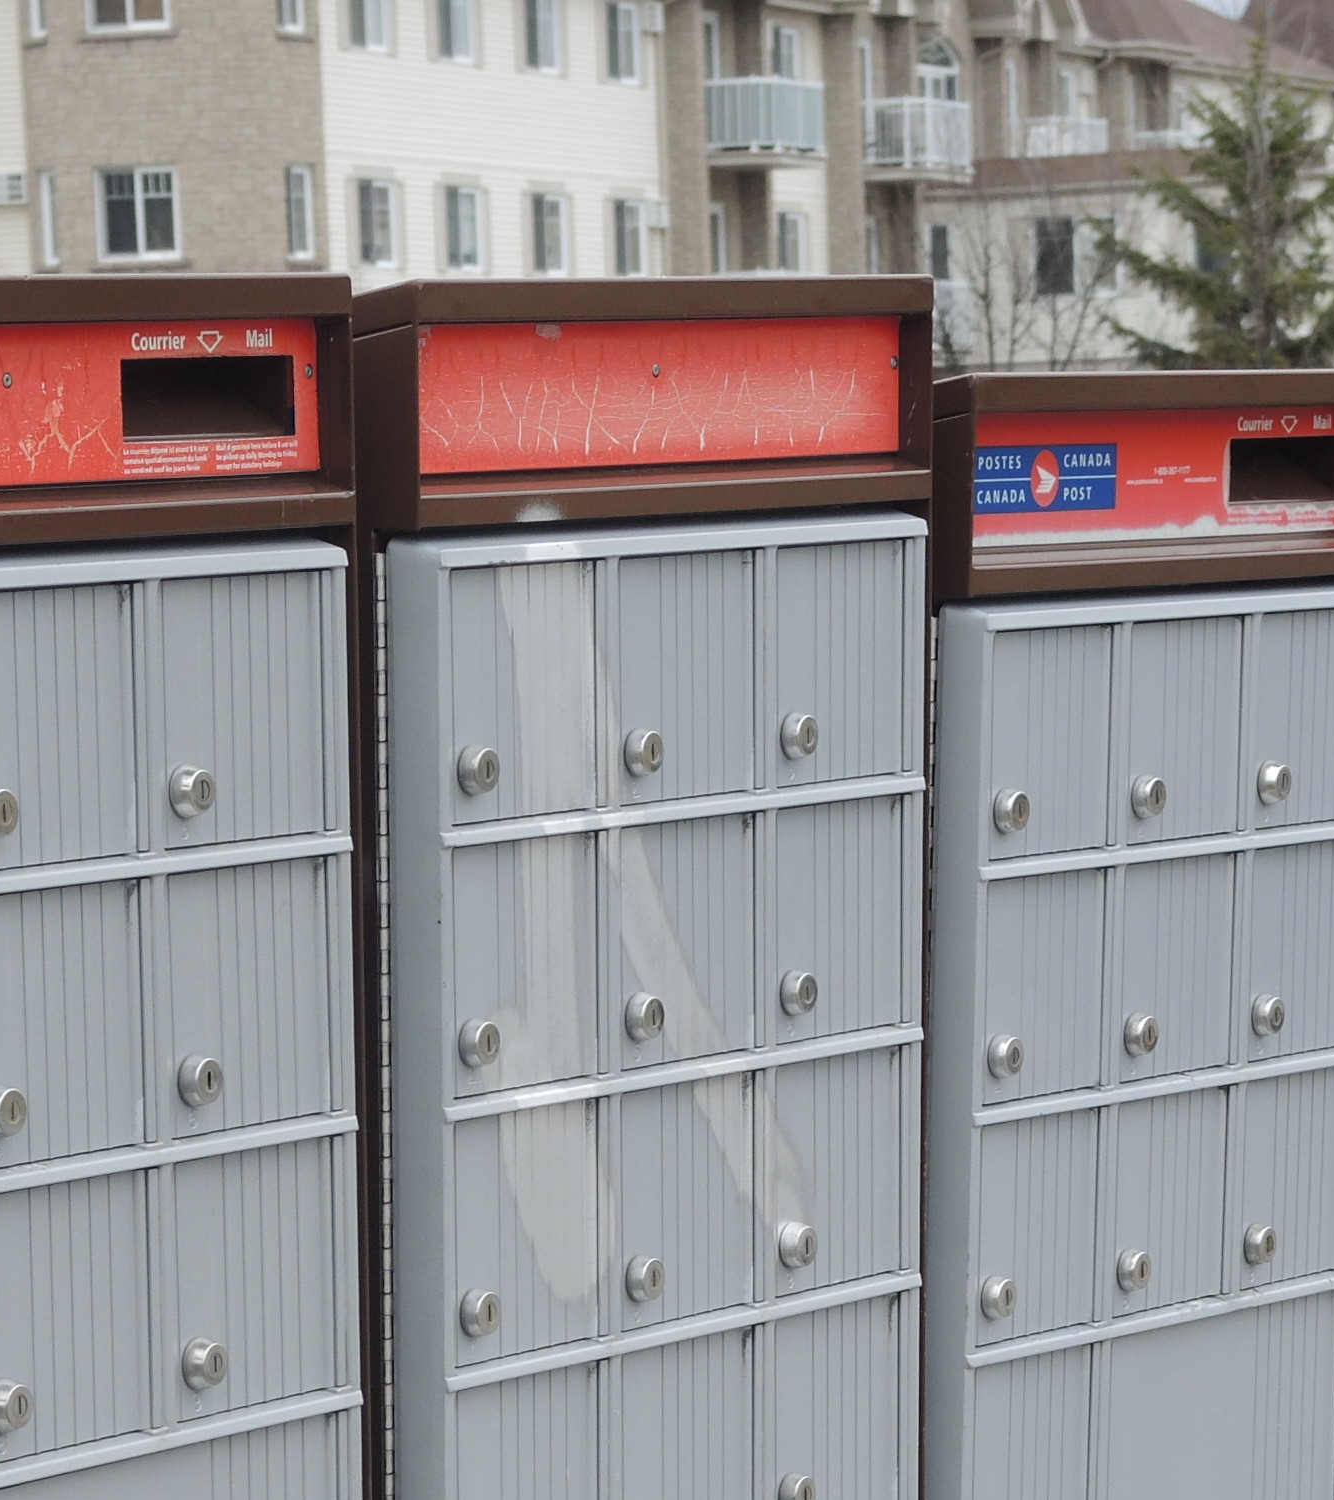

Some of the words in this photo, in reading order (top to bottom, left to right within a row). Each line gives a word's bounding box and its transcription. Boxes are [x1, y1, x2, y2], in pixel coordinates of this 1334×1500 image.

[131, 331, 186, 351] Courrier
[246, 328, 273, 348] Mail
[1237, 415, 1274, 432] Courrier
[1313, 414, 1332, 430] Mail
[978, 455, 1022, 470] POSTES
[1063, 453, 1111, 467] CANADA
[976, 489, 1026, 505] CANADA
[1063, 486, 1092, 501] POST
